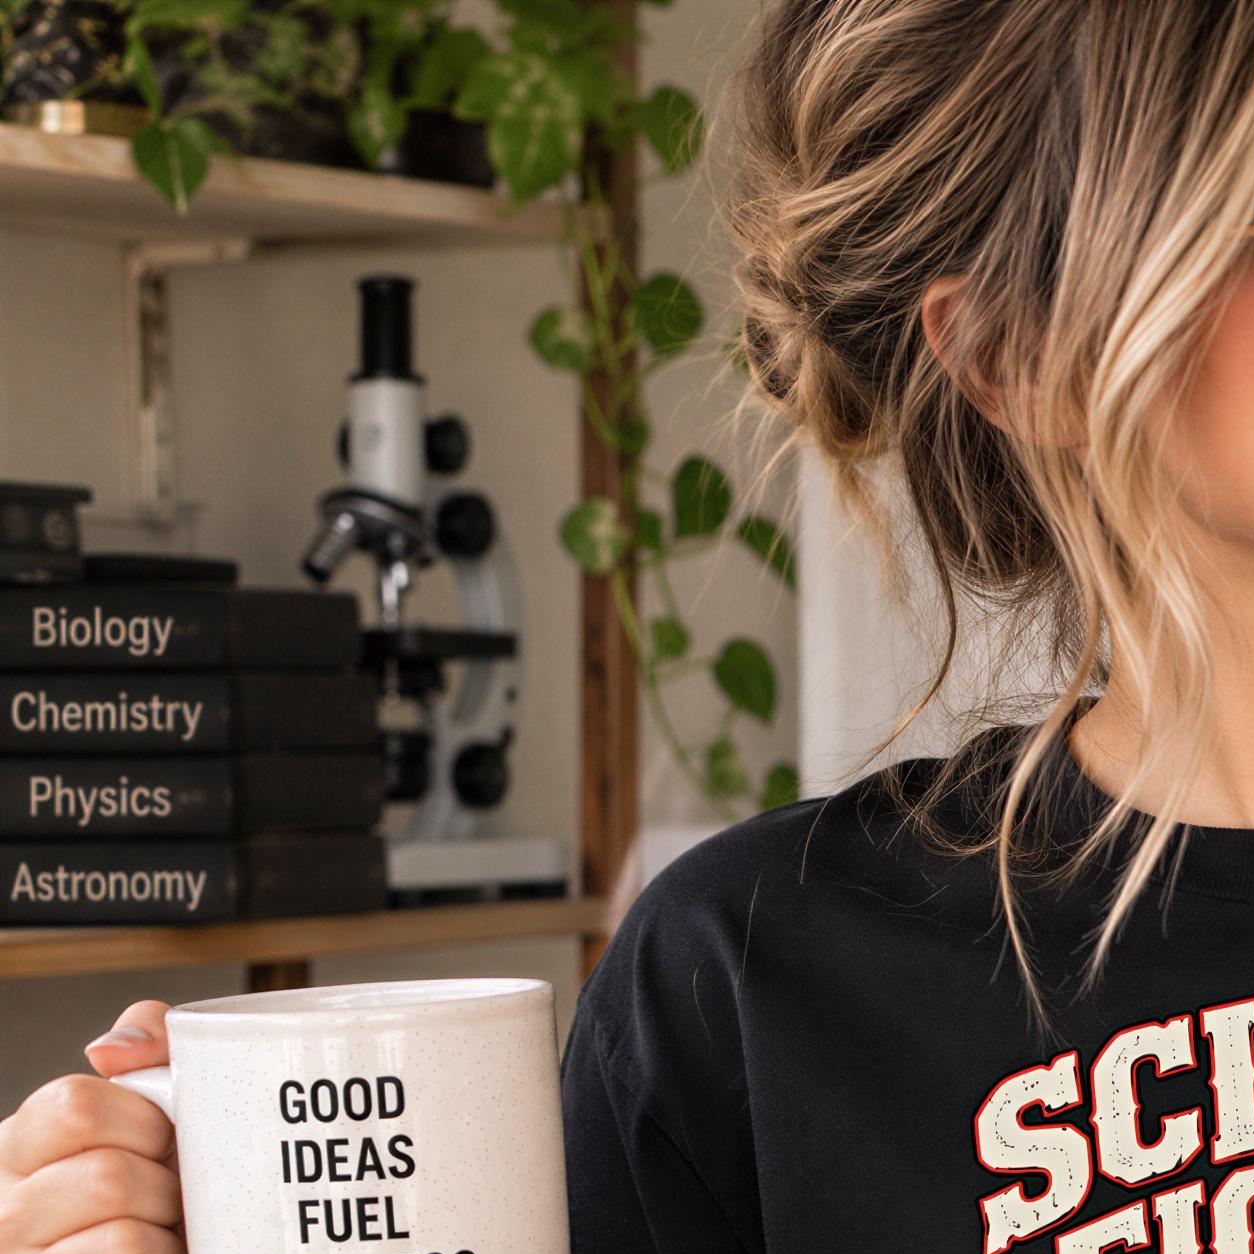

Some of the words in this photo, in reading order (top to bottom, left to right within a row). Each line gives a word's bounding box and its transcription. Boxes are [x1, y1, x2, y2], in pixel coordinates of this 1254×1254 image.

[33, 606, 174, 656] Biology
[11, 691, 203, 741] Chemistry
[29, 775, 172, 826] Physics
[10, 862, 207, 911] Astronomy
[279, 1076, 406, 1124] GOOD
[280, 1134, 416, 1184] IDEAS
[298, 1196, 410, 1244] FUEL
